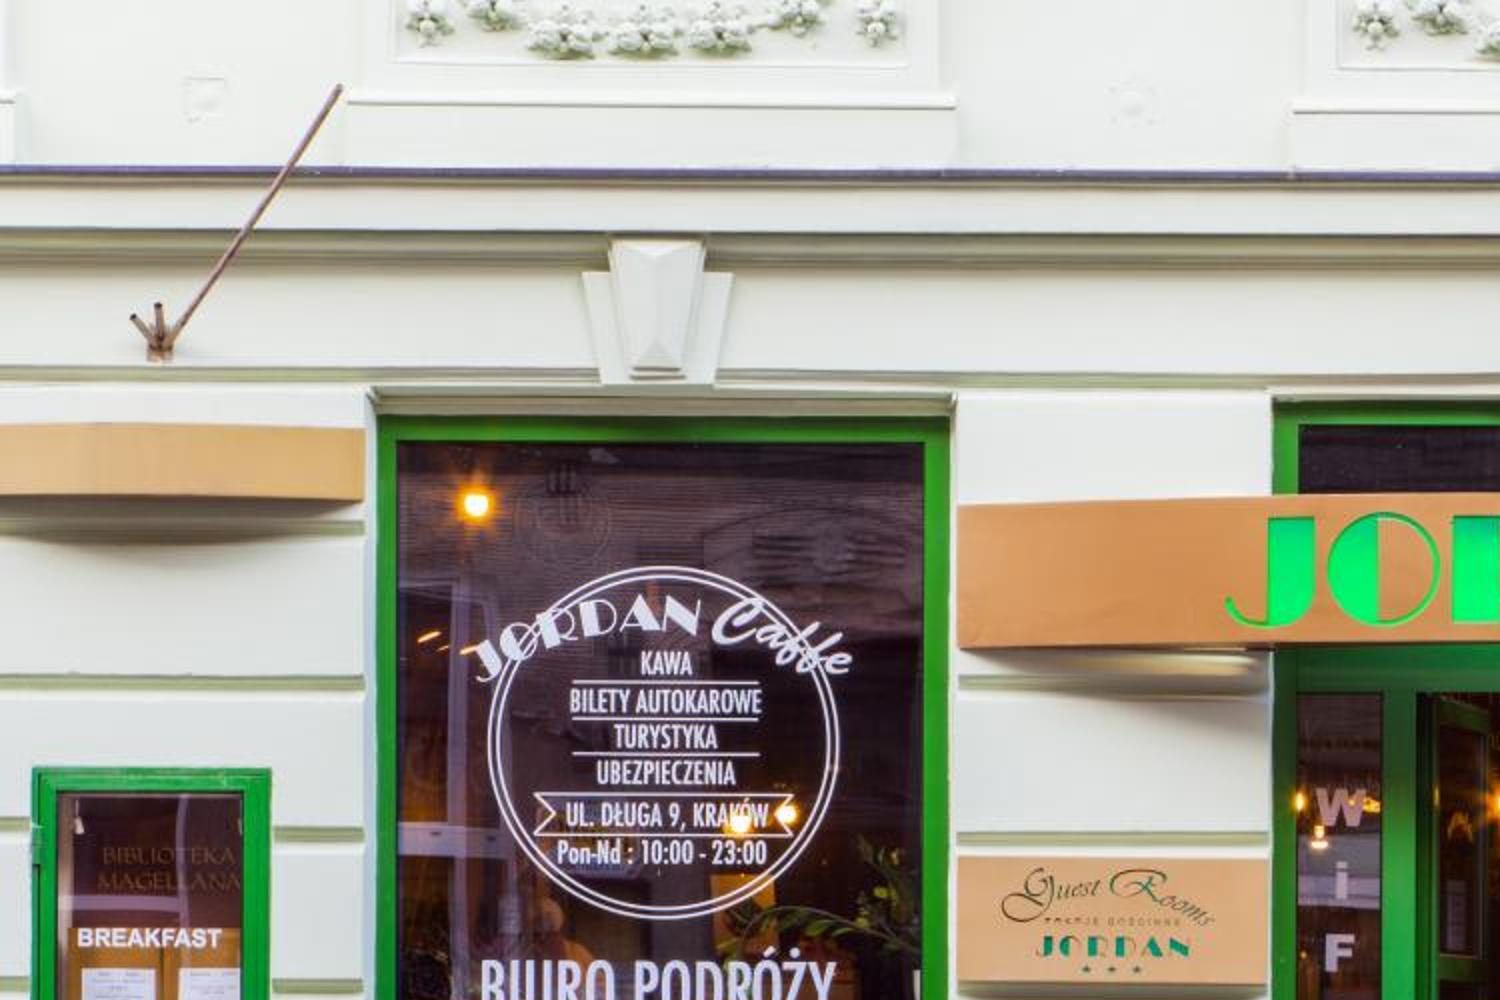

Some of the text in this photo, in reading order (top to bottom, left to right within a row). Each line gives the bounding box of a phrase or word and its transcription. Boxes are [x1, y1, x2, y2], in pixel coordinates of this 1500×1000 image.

[474, 593, 854, 683] JORDAN Caffe
[641, 650, 693, 676] KAWA
[570, 688, 762, 714] BILETY AUTOKAROWE
[614, 723, 718, 749] TURYSTYKA
[597, 760, 736, 785] UBEZPIECZENIA
[565, 798, 768, 832] UL. DŁUGA 9, KRAKÓW
[103, 847, 236, 865] BIBLIOEKA
[557, 839, 621, 865] Pon-Nd
[642, 840, 693, 865] 10:00
[712, 840, 767, 865] 23:00
[96, 871, 240, 891] MAGELANA
[1001, 867, 1215, 927] Guest Rooms
[77, 927, 223, 949] BREAKFAST
[1035, 935, 1192, 958] JORDAN
